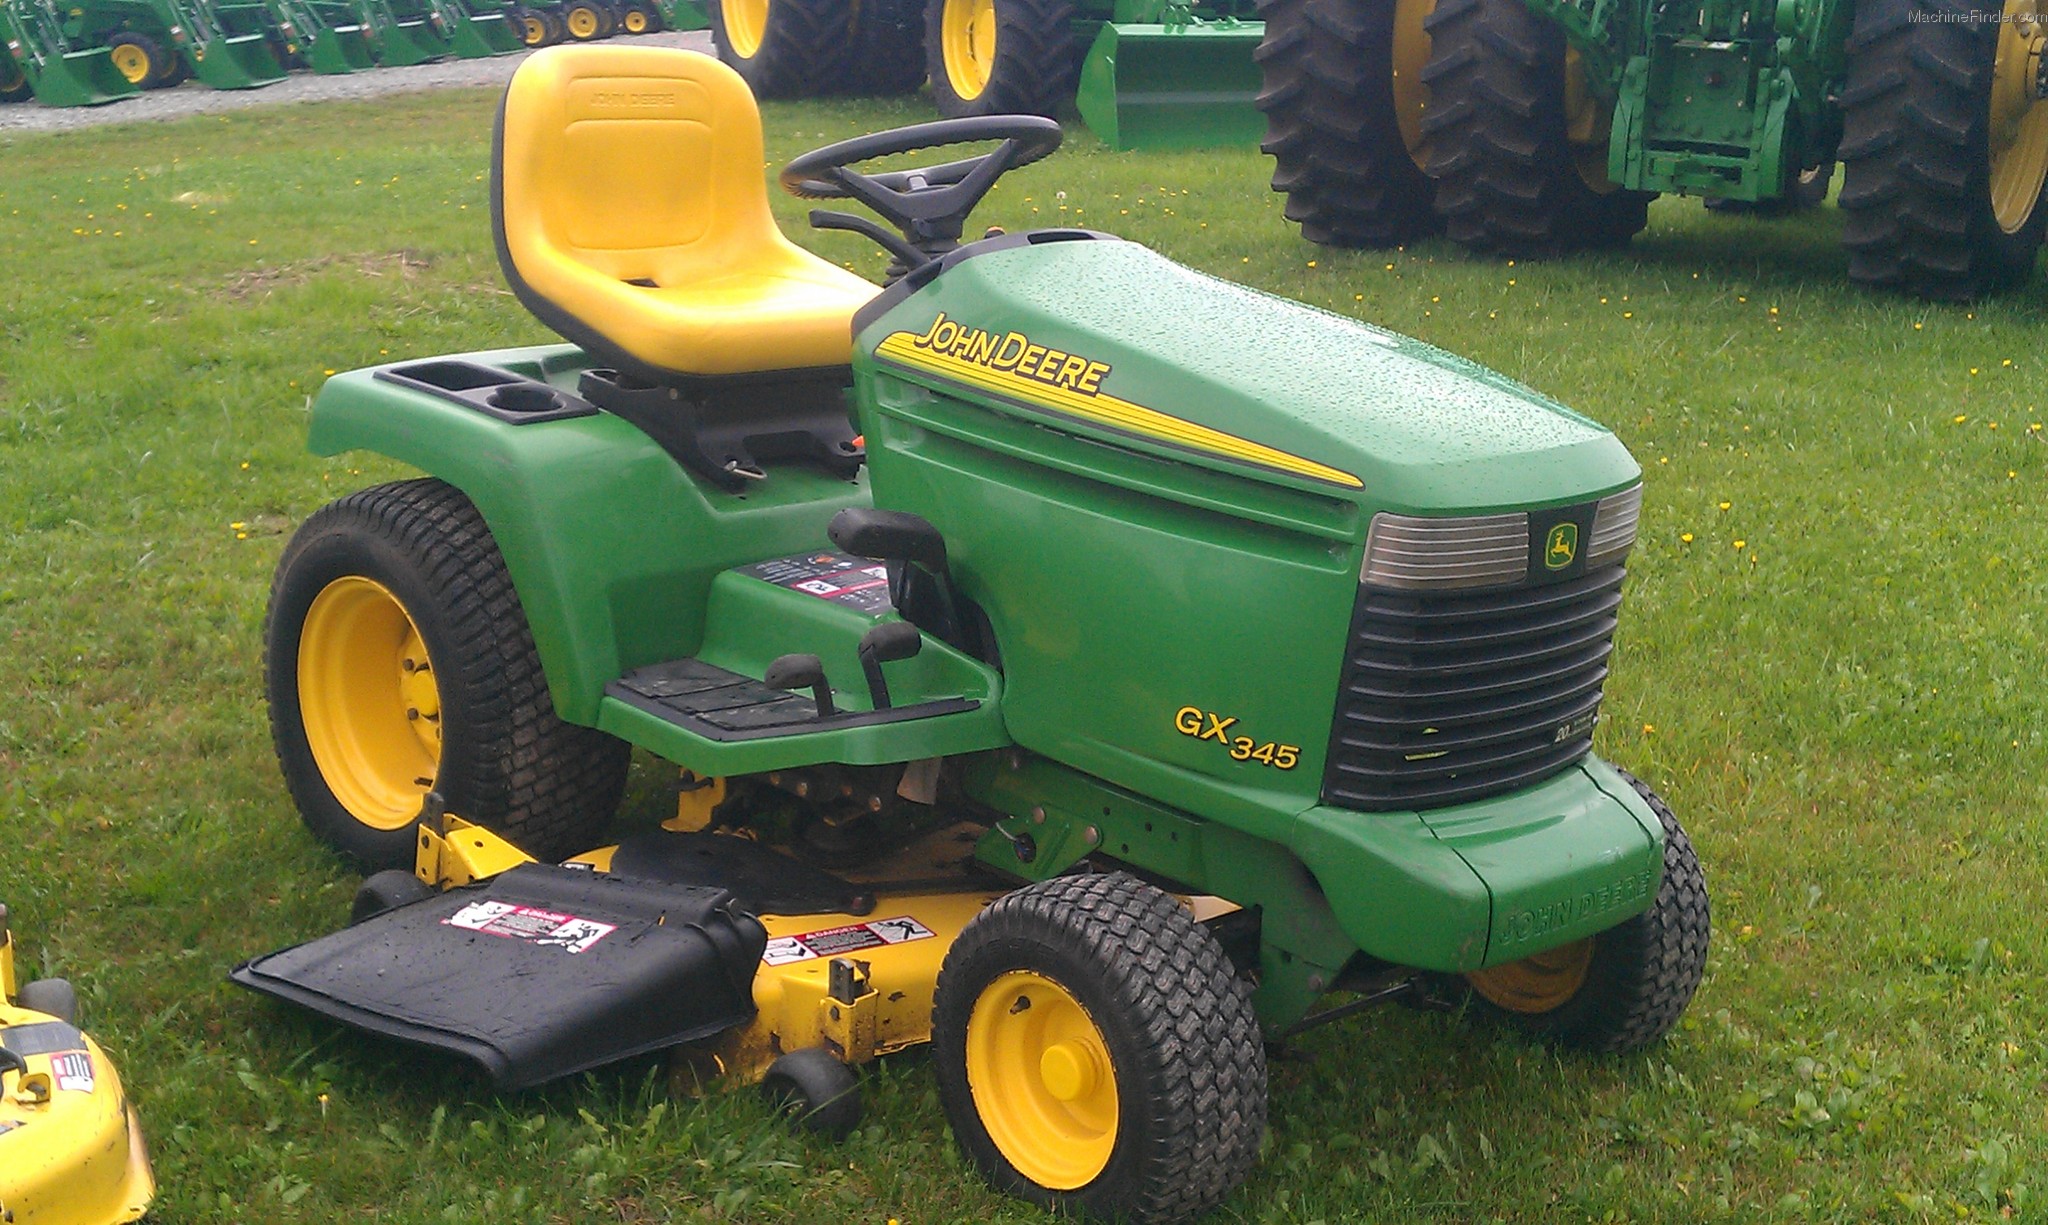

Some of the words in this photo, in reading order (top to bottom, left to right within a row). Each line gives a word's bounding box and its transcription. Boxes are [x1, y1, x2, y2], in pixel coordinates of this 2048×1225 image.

[914, 312, 1001, 366] JOHN
[992, 331, 1112, 396] DEERE
[1229, 735, 1301, 770] 345
[1500, 898, 1573, 945] JOHN
[1577, 869, 1651, 922] DEERE
